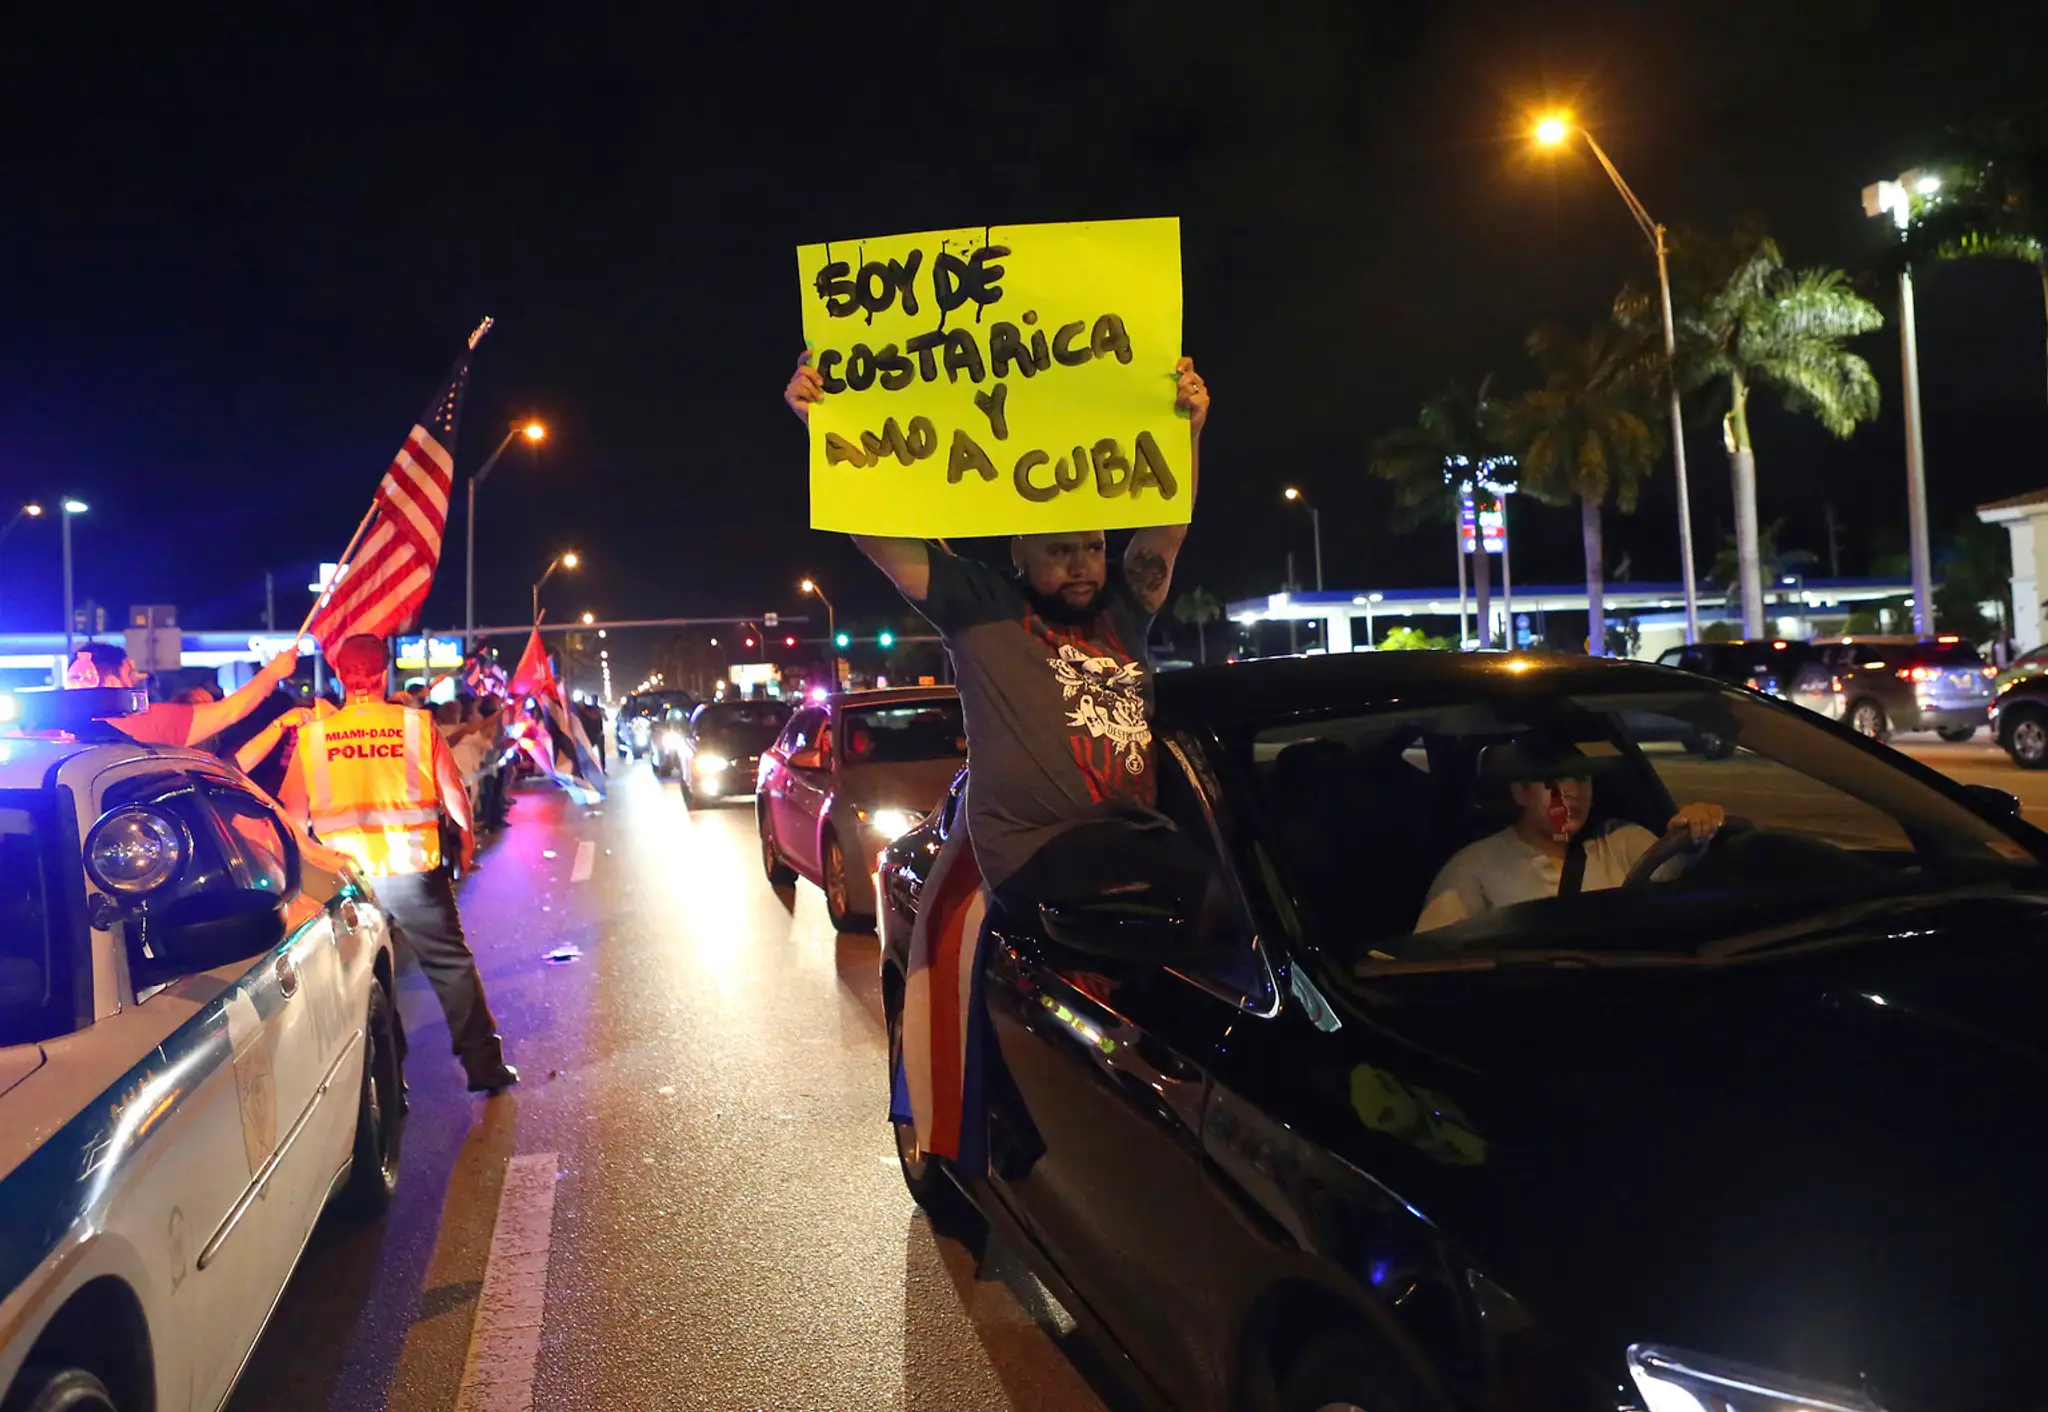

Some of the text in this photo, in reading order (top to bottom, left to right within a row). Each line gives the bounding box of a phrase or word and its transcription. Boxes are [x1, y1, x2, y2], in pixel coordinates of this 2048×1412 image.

[814, 246, 1011, 319] SOY DE
[975, 383, 1008, 440] Y
[826, 416, 1178, 502] AMO A CUBA
[325, 728, 404, 742] MIAMI-DADE
[327, 744, 404, 762] POLICE
